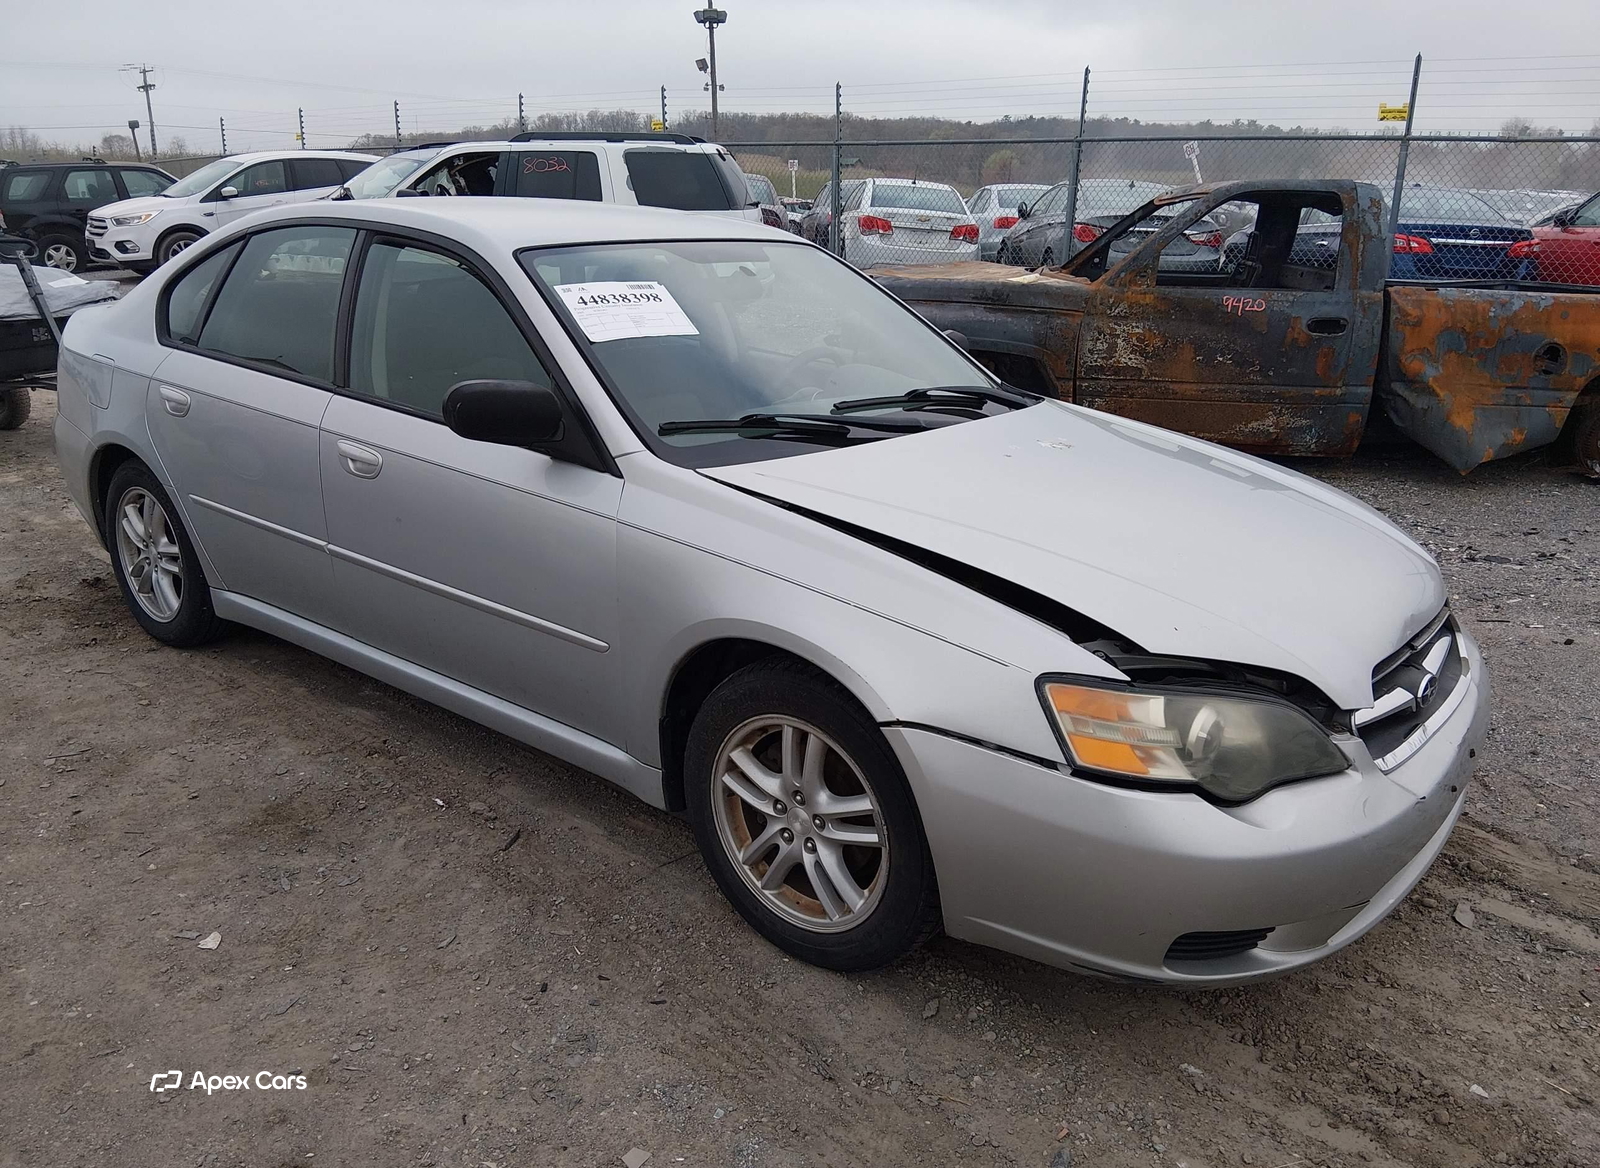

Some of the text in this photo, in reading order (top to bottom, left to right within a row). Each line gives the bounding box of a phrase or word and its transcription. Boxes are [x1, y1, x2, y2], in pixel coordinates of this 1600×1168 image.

[523, 156, 571, 173] 8032
[577, 293, 662, 305] 44838398
[1223, 296, 1266, 316] 9420
